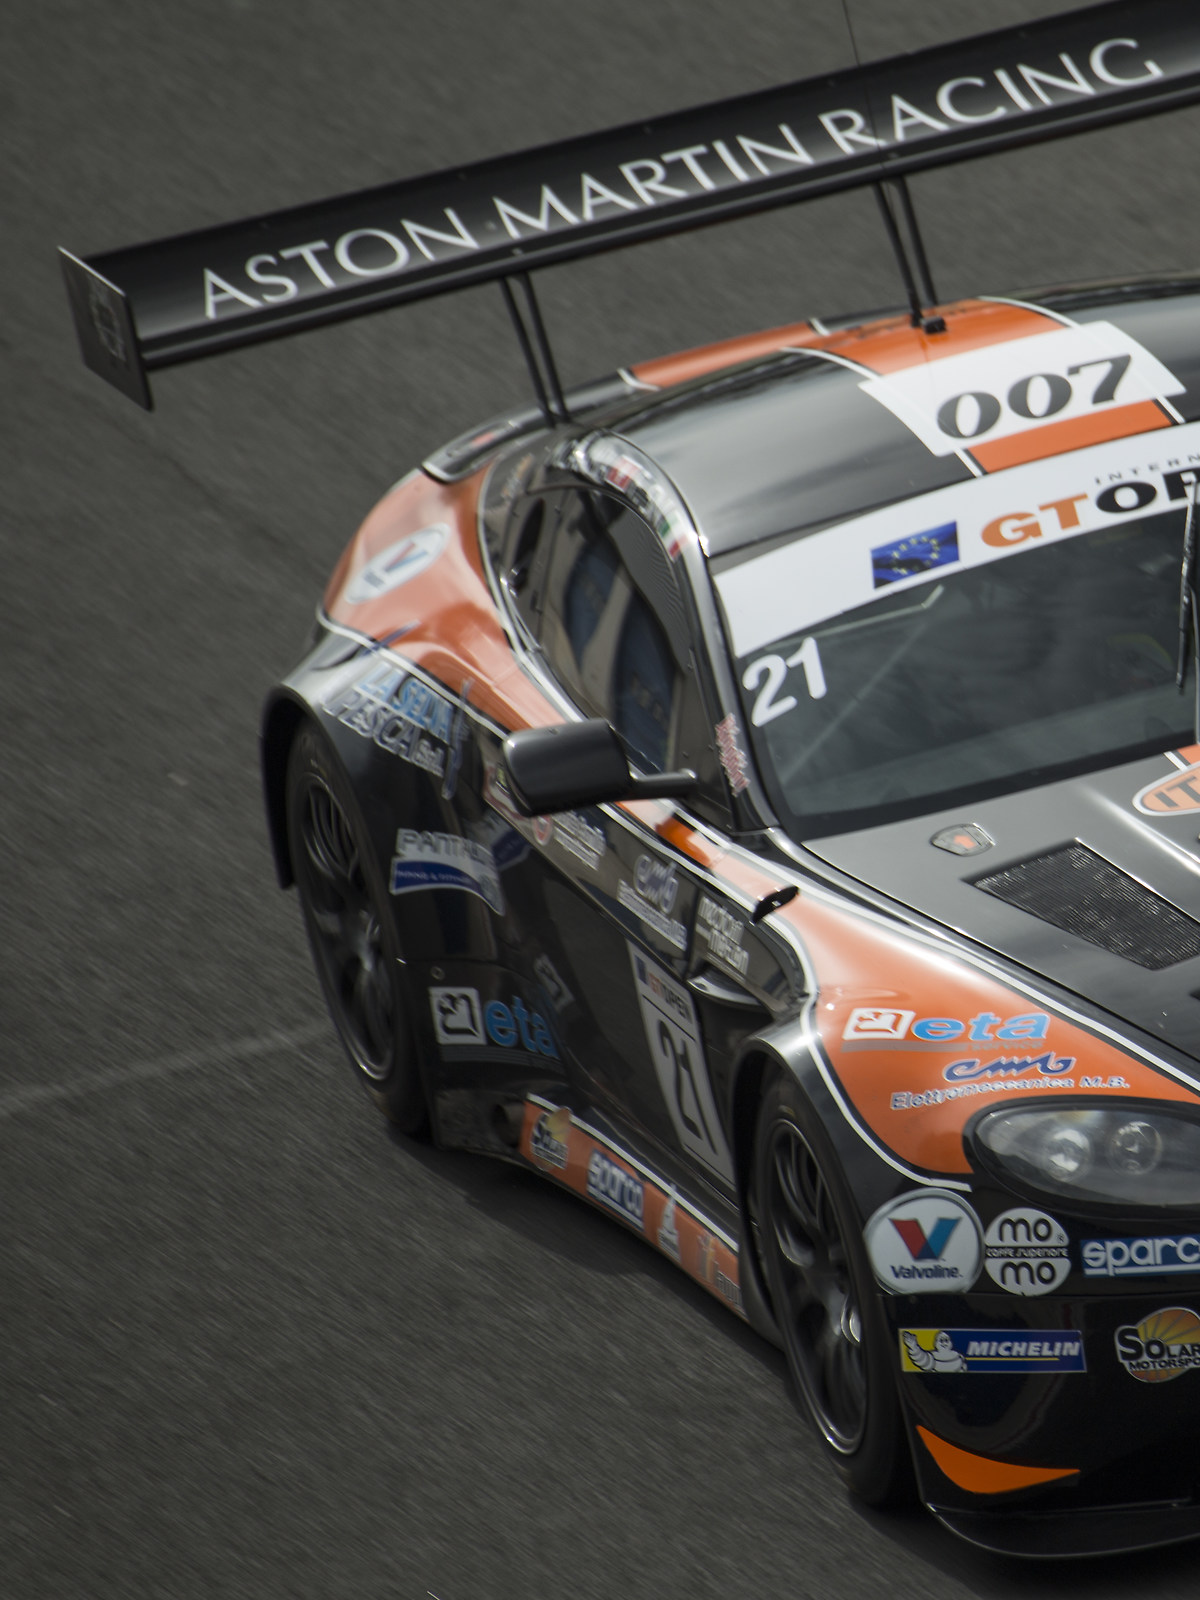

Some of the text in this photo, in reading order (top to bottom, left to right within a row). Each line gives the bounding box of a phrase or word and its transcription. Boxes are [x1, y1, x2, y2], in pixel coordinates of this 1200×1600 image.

[204, 38, 1164, 319] ASTON MARTIN RACING
[937, 354, 1132, 439] 007
[742, 637, 827, 727] 21
[484, 995, 560, 1060] eta
[911, 1011, 1051, 1041] eta
[1080, 1075, 1131, 1089] M.B.
[890, 1264, 960, 1280] Valvoline
[966, 1339, 1081, 1358] MICHELIN
